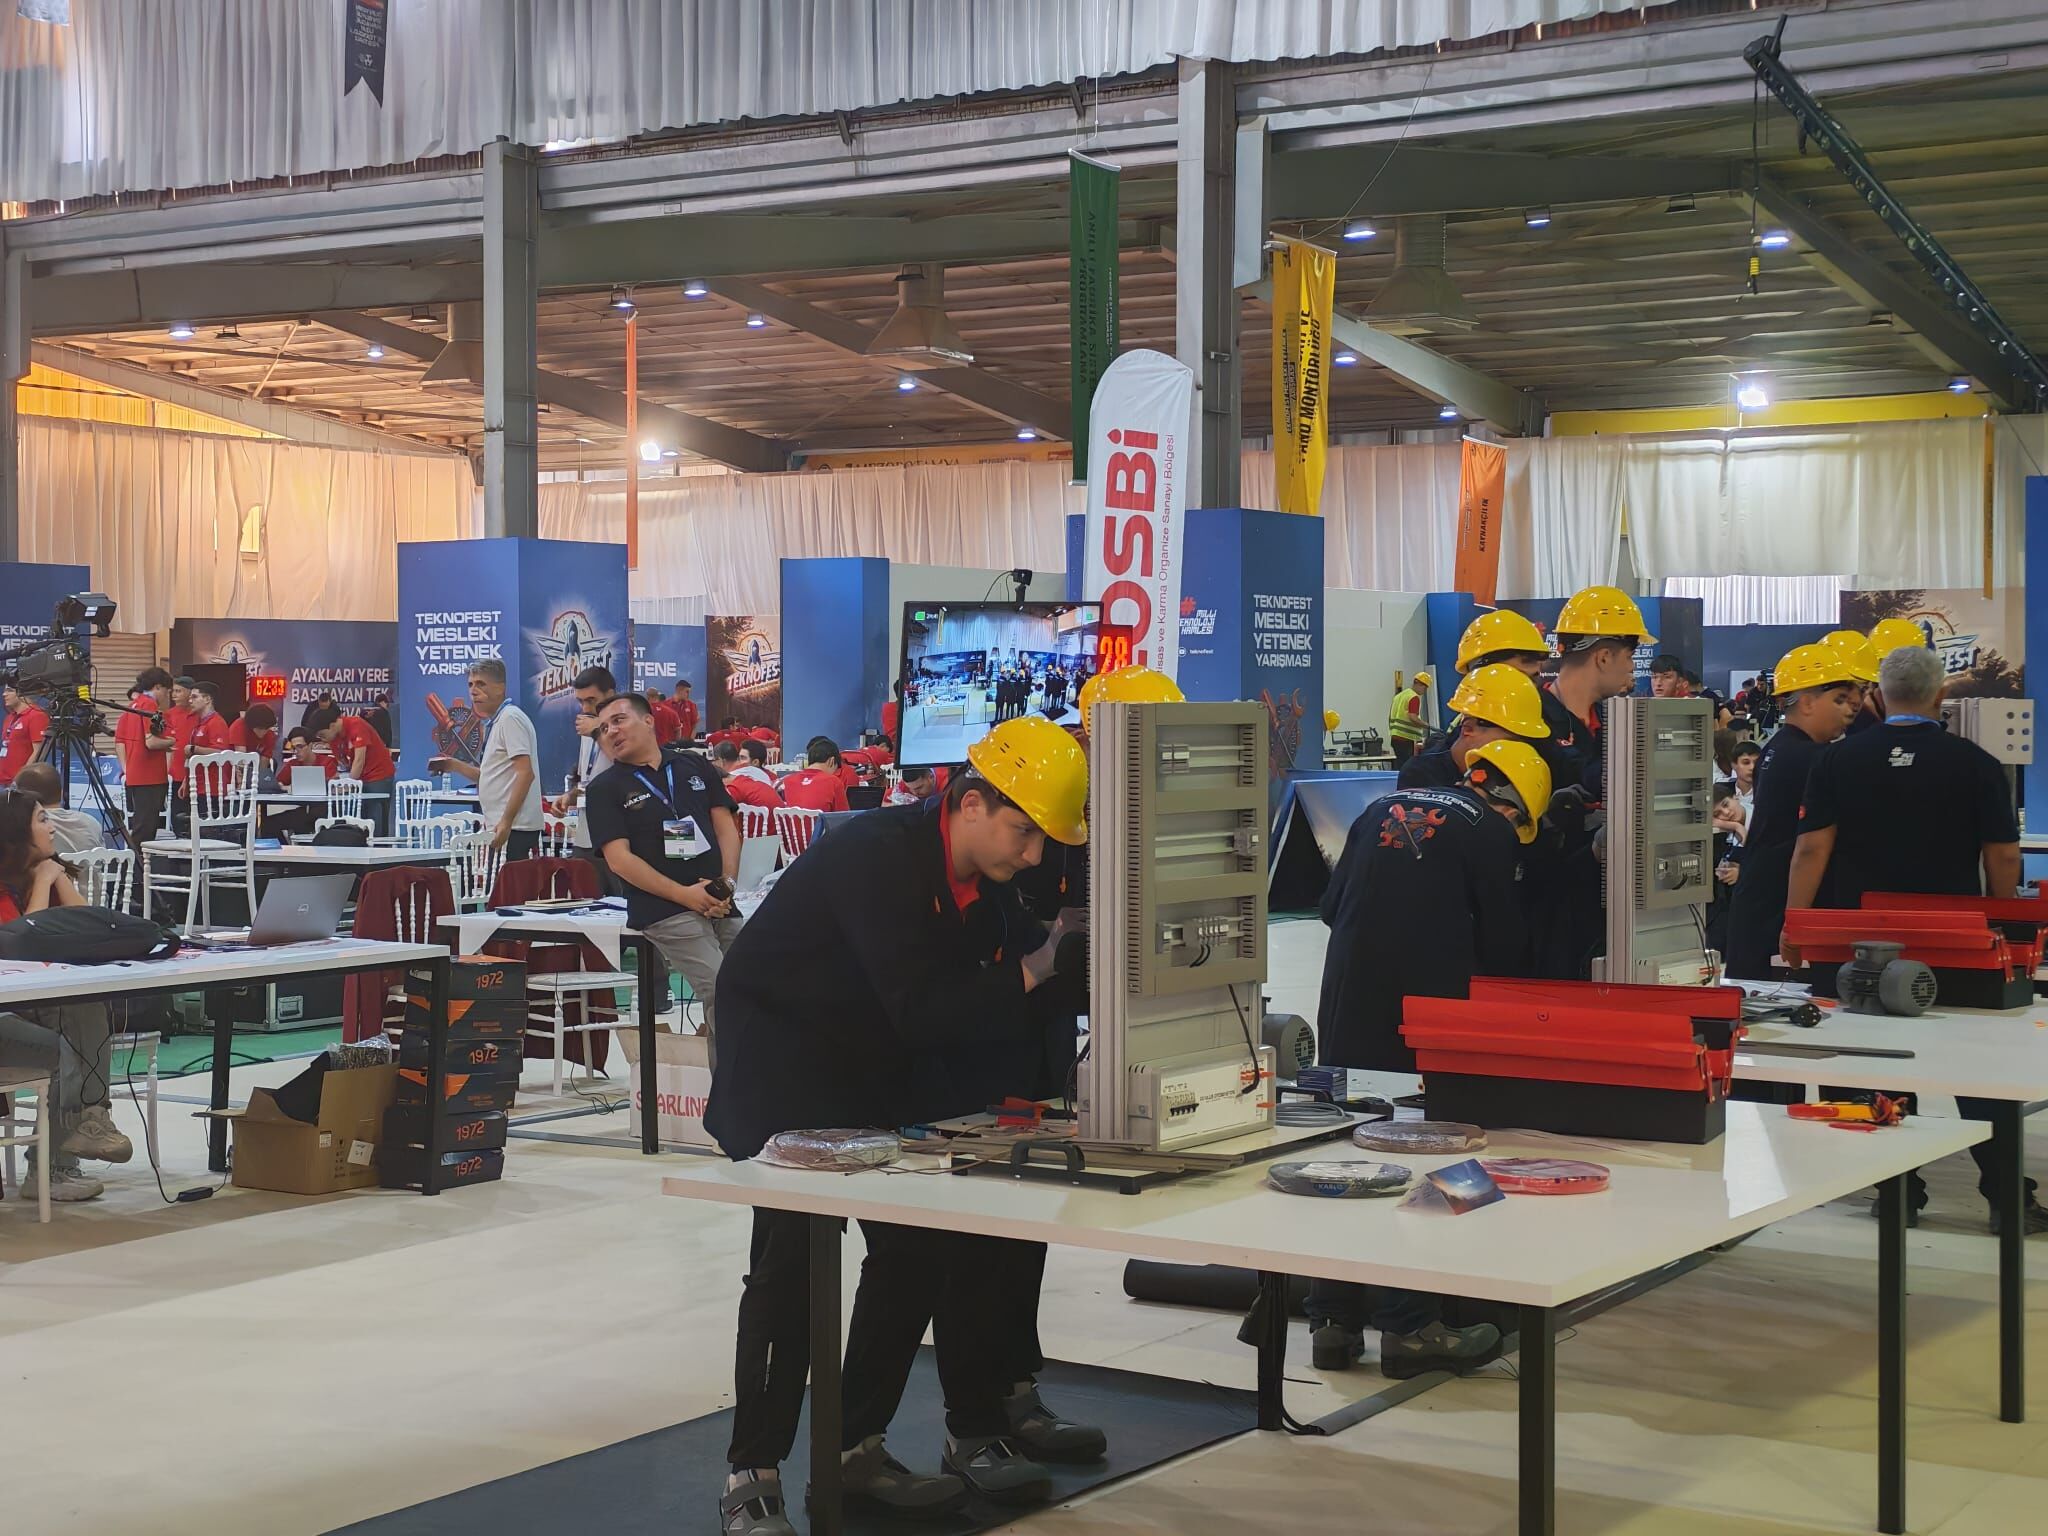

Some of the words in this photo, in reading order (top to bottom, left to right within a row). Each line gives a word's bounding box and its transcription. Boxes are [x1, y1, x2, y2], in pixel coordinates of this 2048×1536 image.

[1163, 434, 1175, 479] Bölgesi
[1162, 483, 1173, 523] Sanayi
[1159, 528, 1171, 580] Organize
[1157, 585, 1168, 623] Karma
[1253, 594, 1313, 610] TEKNOFEST
[415, 610, 502, 625] TEKNOFEST
[1179, 617, 1215, 627] EKNOLOJİ
[417, 626, 497, 643] MESLEKİ
[1158, 628, 1165, 642] ve
[1252, 632, 1313, 651] YETENEK
[53, 653, 66, 661] TRT
[415, 643, 503, 661] YETENEK
[1255, 653, 1311, 668] YARIŞMASI
[291, 668, 355, 683] AYAKLARI
[358, 668, 389, 683] YERE
[418, 662, 475, 676] YARIŞM
[727, 662, 781, 695] TEKNOFES
[476, 970, 504, 990] 1972
[469, 1045, 499, 1065] 1972
[635, 1091, 709, 1118] SARLIN
[456, 1121, 485, 1141] 1972
[454, 1157, 482, 1176] 1972
